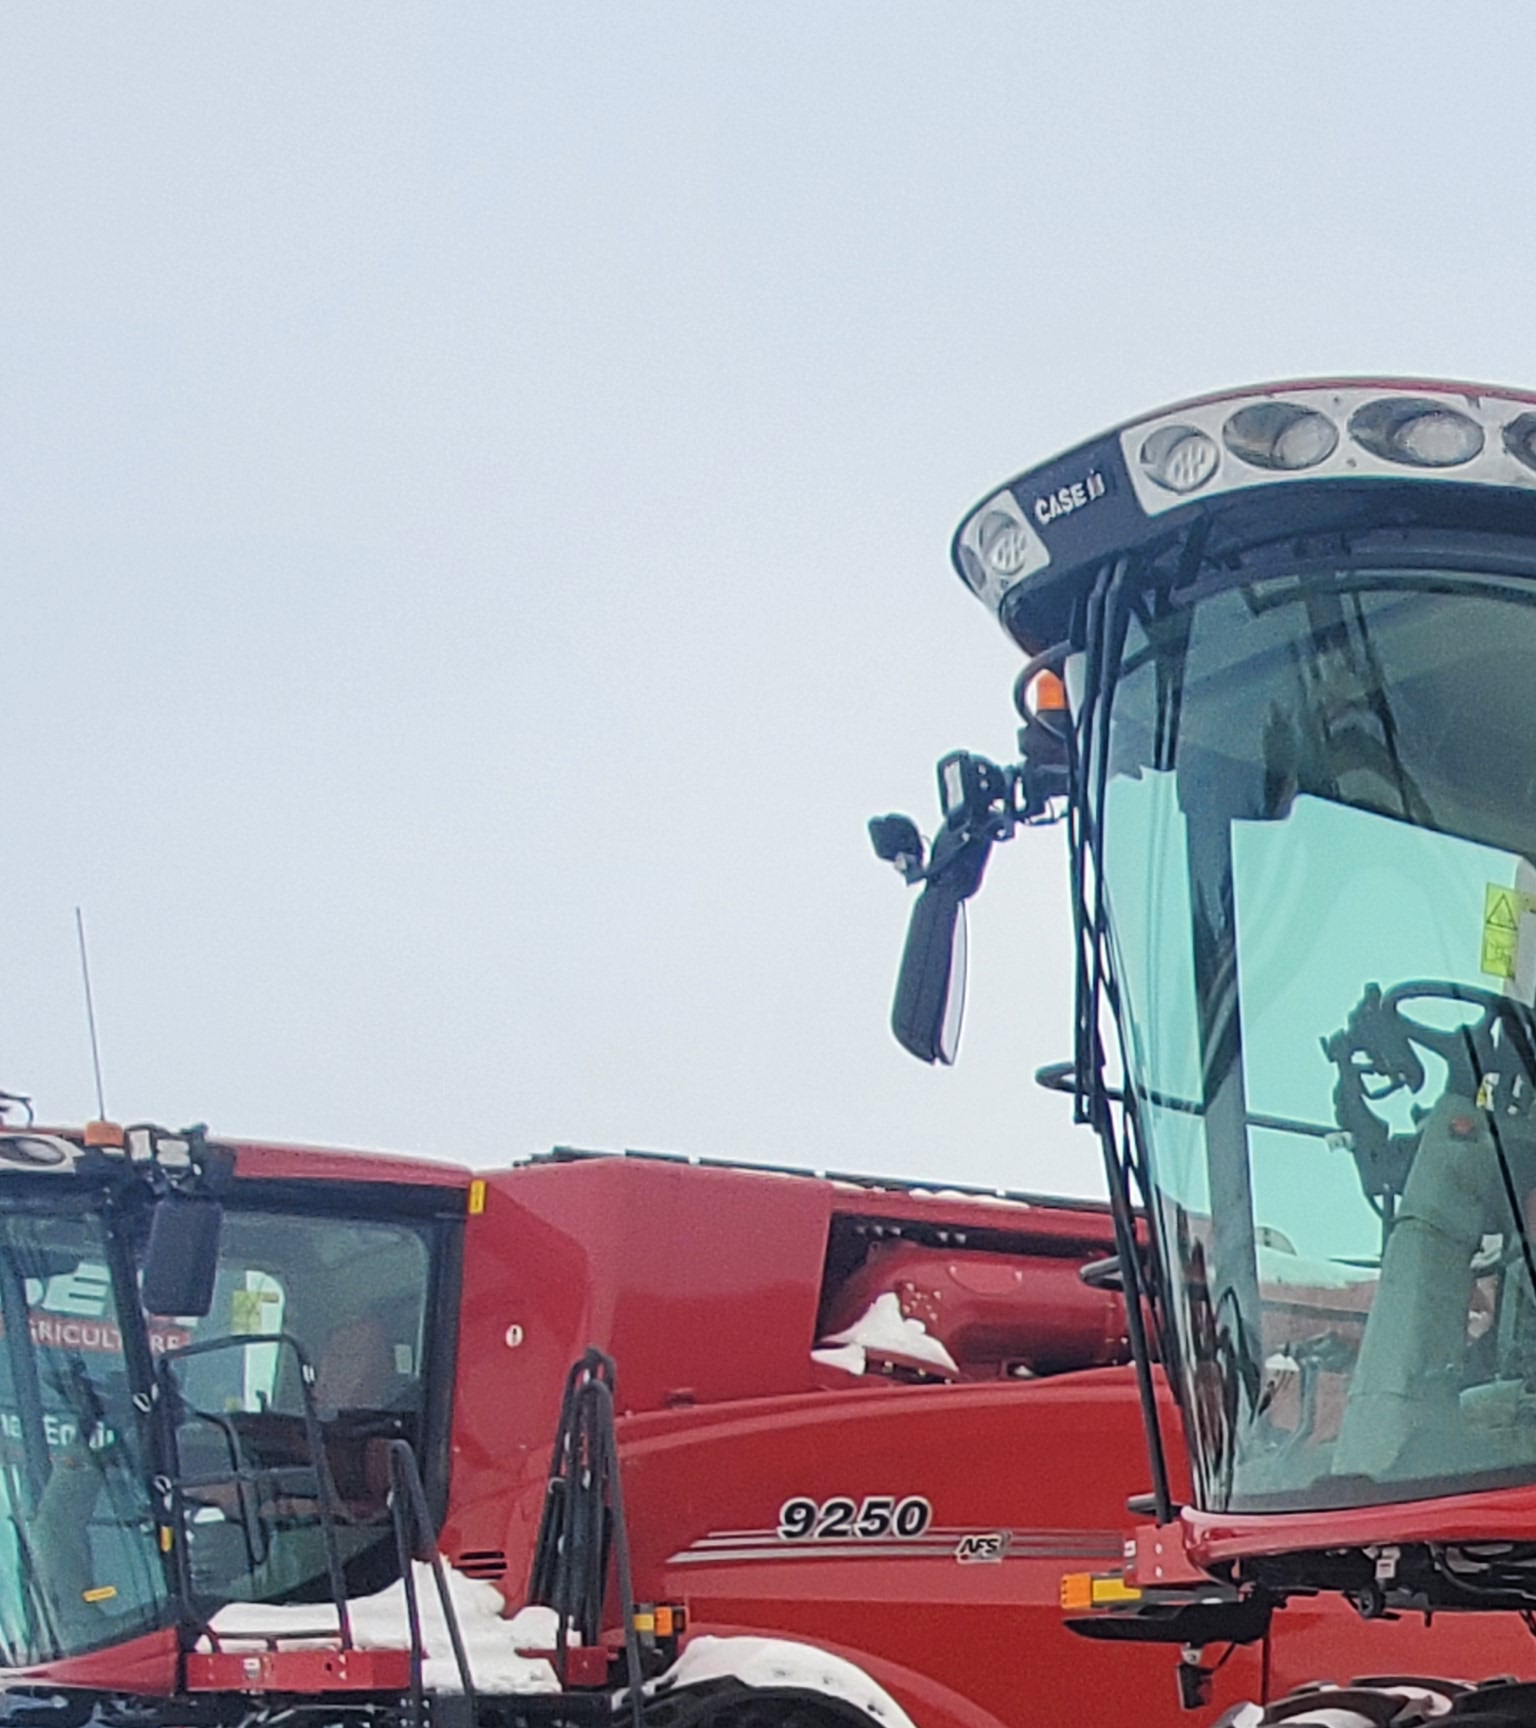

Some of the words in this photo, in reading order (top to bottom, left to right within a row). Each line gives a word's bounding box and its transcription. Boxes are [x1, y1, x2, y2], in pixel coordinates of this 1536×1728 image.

[1034, 481, 1087, 525] CASE
[776, 1495, 933, 1542] 9250
[956, 1535, 1001, 1556] AFS
